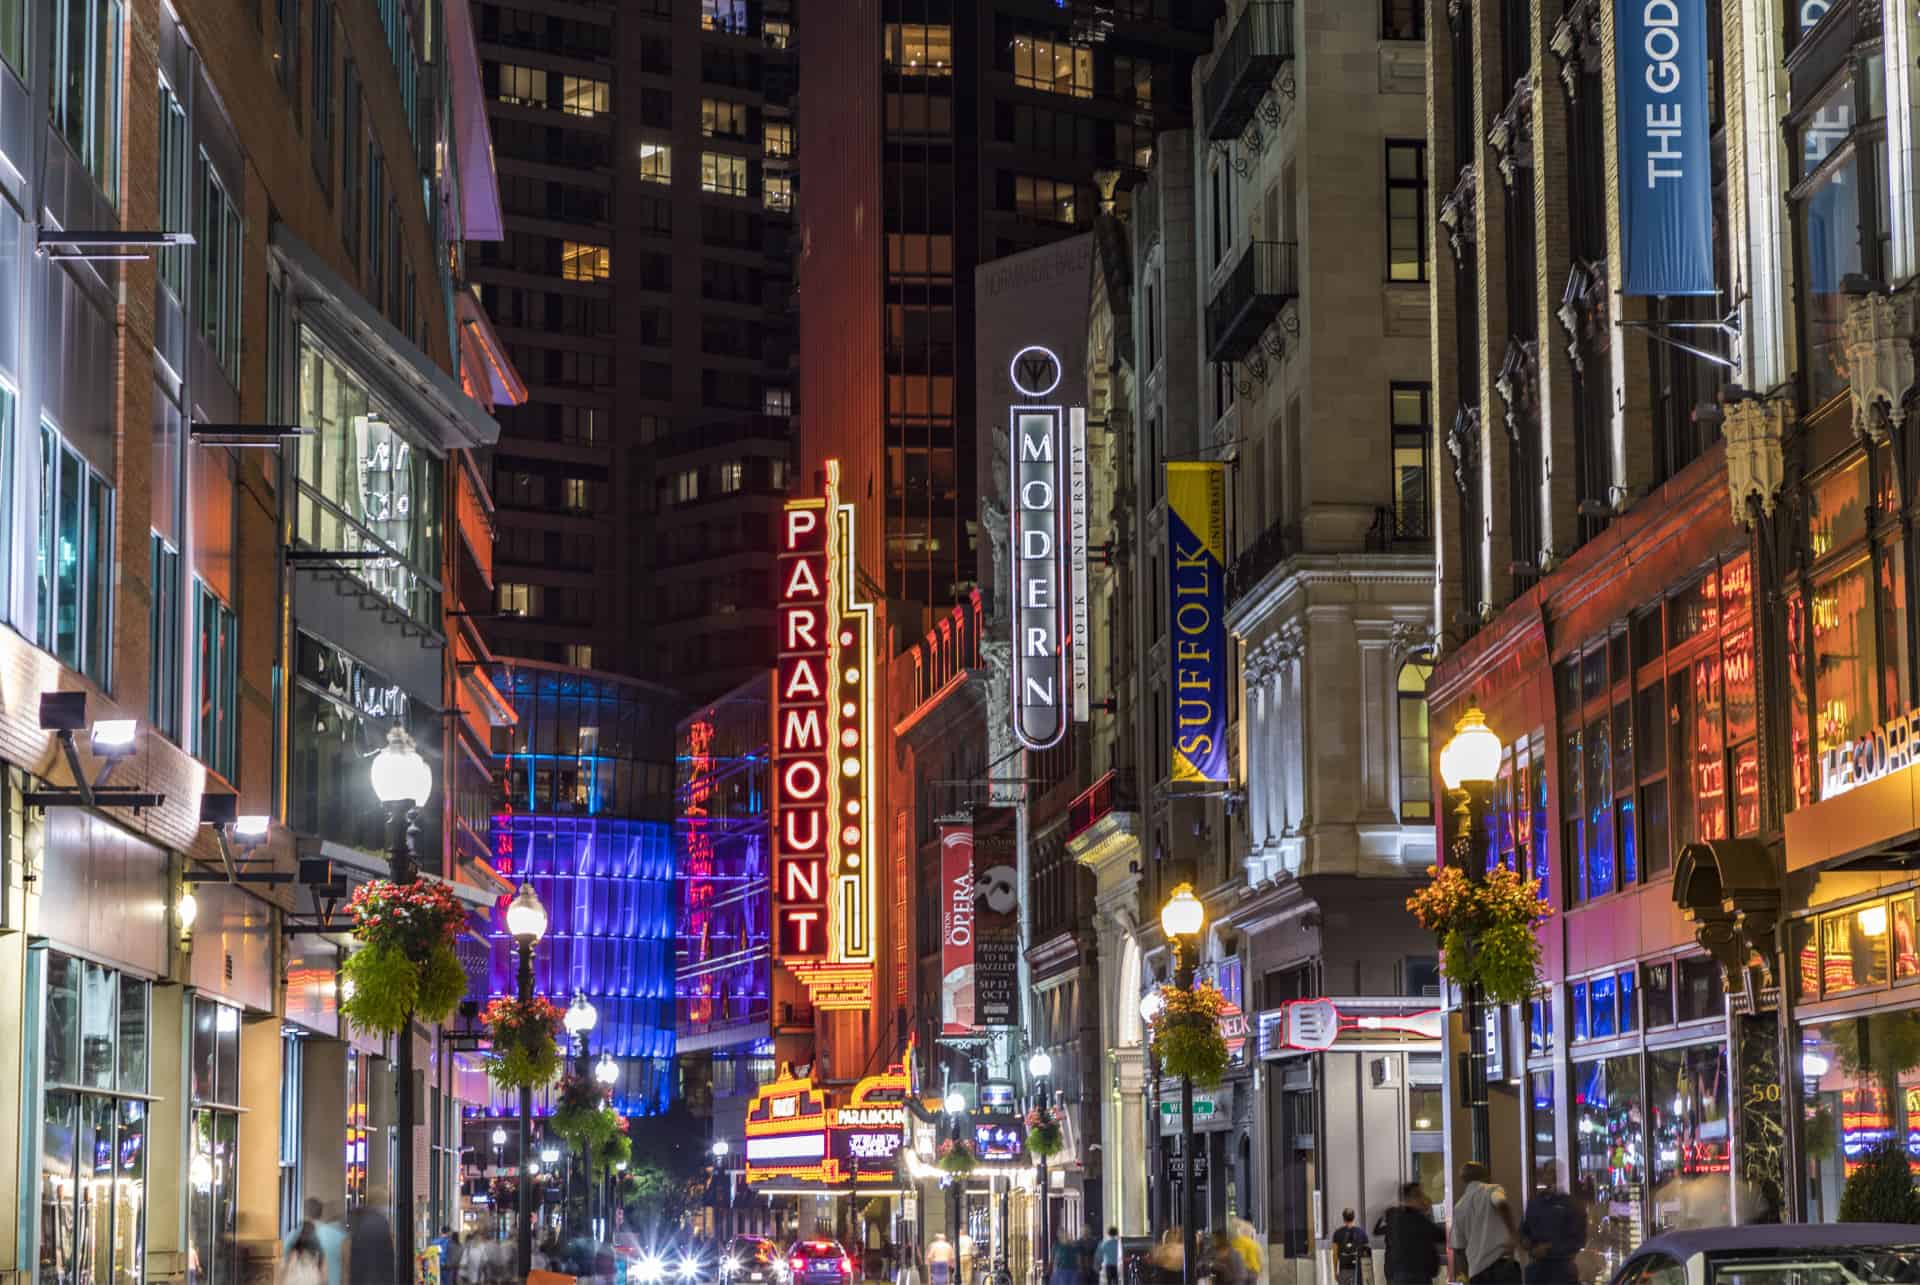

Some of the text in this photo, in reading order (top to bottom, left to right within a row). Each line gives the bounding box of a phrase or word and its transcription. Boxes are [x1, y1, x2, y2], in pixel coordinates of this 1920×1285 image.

[1647, 103, 1683, 188] THE
[1208, 468, 1222, 551] UNIVERSITY
[1021, 432, 1053, 706] MODERN
[1072, 446, 1087, 690] SUFFOLK UNIVERSITY
[1176, 543, 1213, 755] SUFFOLK
[784, 508, 822, 953] PARAMOUNT
[951, 873, 970, 947] OPERA
[975, 962, 1015, 972] DAZZLED
[982, 991, 1003, 1001] OCT
[838, 1109, 905, 1125] PARAMOUN
[1751, 1083, 1780, 1102] 50
